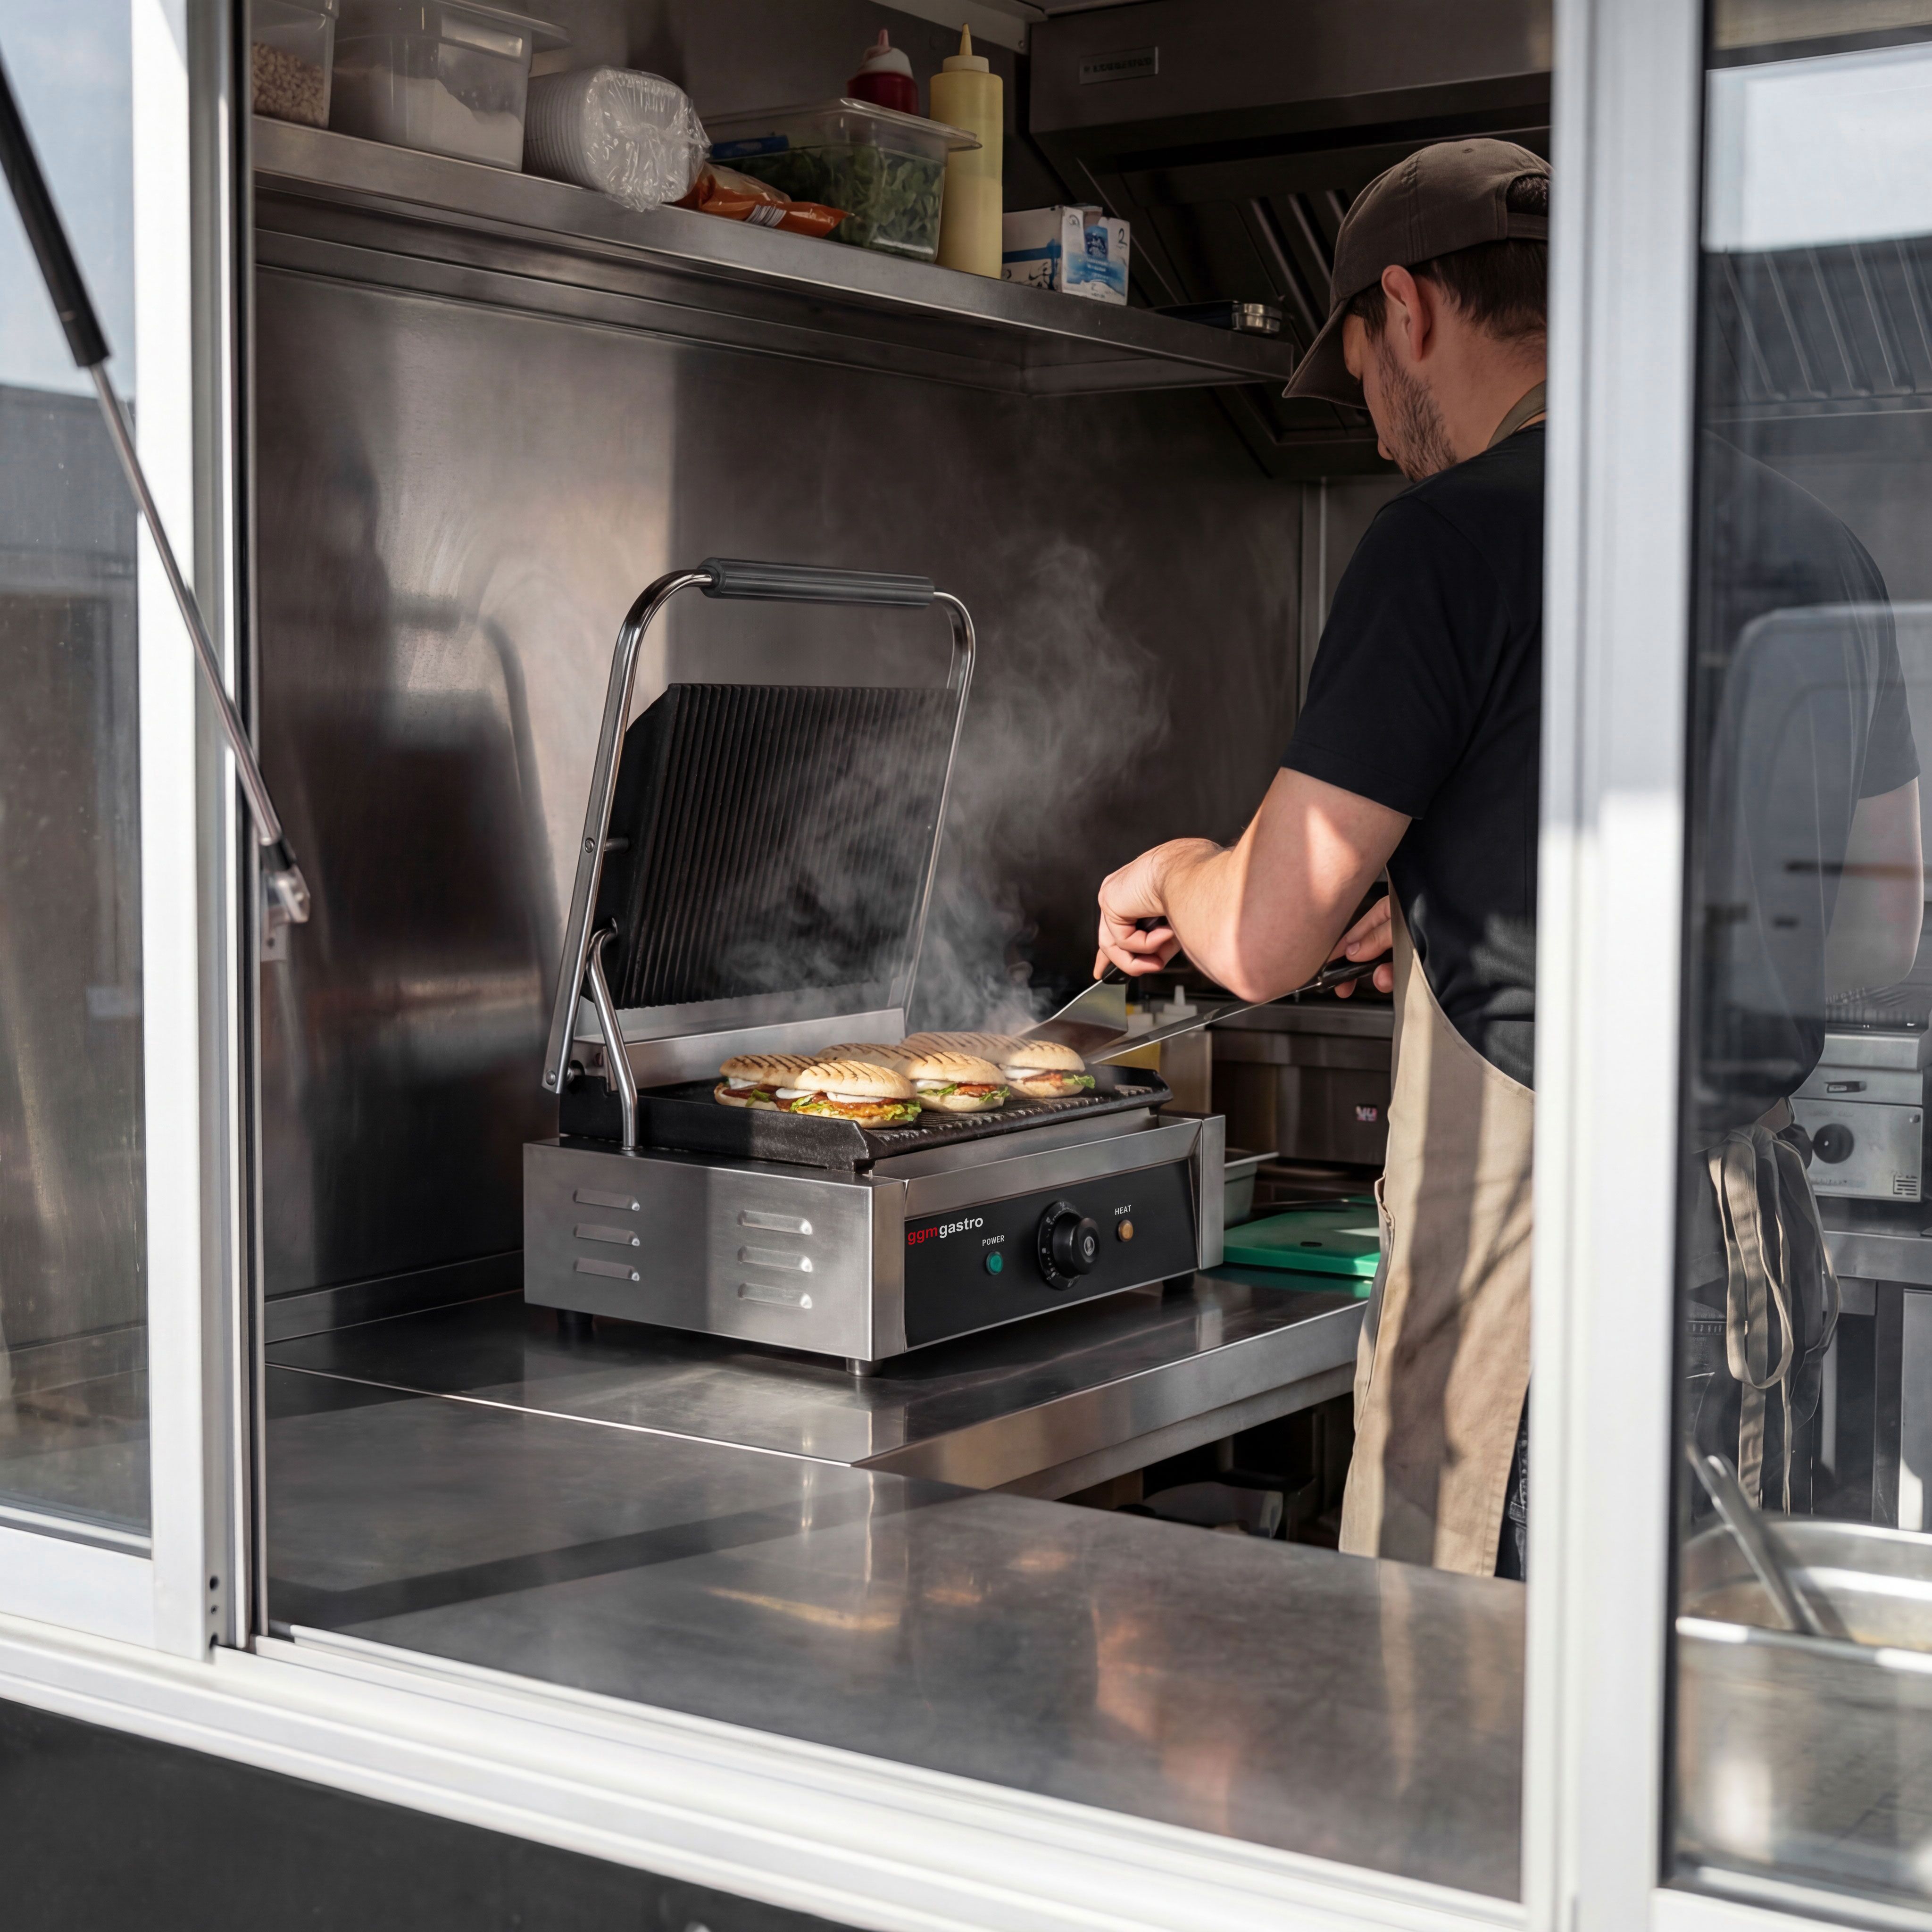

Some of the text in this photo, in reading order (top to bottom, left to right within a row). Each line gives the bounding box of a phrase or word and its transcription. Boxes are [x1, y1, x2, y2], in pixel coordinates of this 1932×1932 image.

[1115, 1205, 1132, 1215] HEAT
[908, 1217, 983, 1245] ggmgastro
[982, 1235, 1005, 1247] POWER
